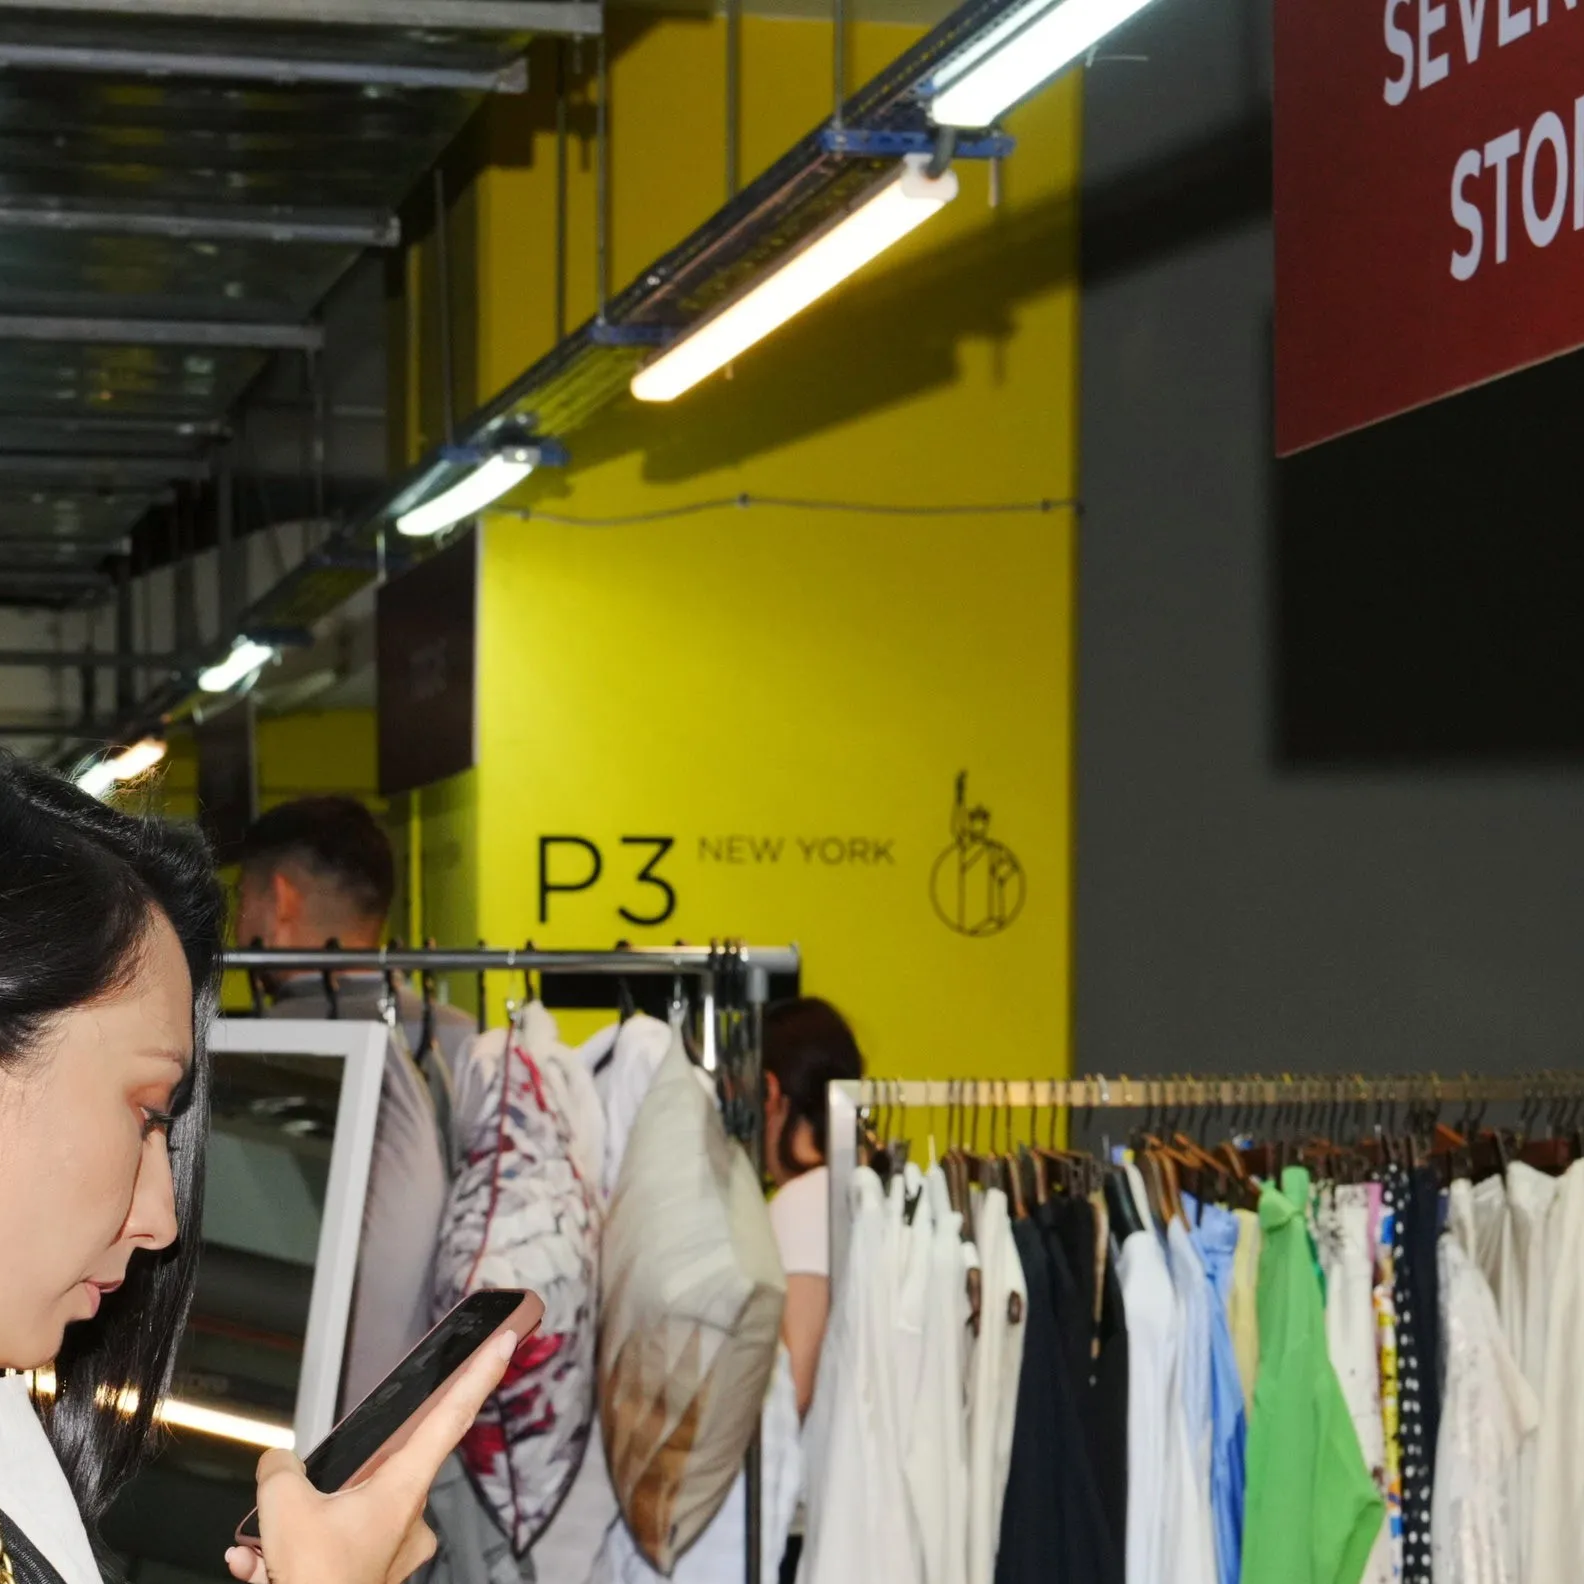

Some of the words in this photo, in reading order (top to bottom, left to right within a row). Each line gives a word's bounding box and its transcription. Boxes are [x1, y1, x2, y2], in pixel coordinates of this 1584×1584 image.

[1383, 0, 1577, 106] SEV
[538, 835, 677, 926] P3
[698, 836, 785, 864] NEW
[796, 837, 895, 865] YORK
